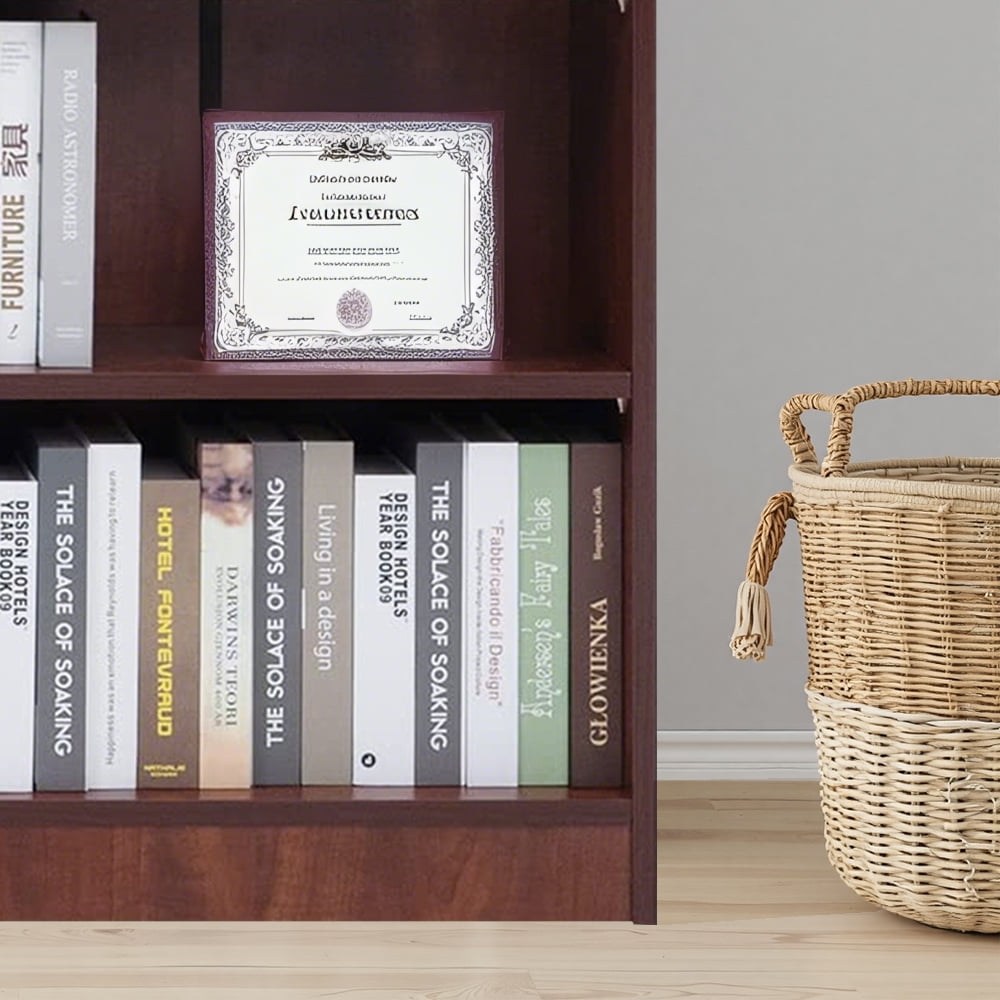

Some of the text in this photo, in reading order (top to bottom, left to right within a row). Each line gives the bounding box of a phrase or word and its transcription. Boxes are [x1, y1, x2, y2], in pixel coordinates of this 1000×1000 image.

[1, 124, 28, 177] 家具
[63, 70, 78, 240] RADIO ASTRONOMER
[1, 195, 24, 310] FURNITURE
[0, 501, 14, 542] YEAR
[13, 500, 28, 626] DESIGN HOTELS
[107, 552, 116, 571] was
[379, 493, 393, 534] YEAR
[394, 494, 408, 618] DESIGN HOTELS
[55, 485, 74, 756] THE SOLACE OF SOAKING
[157, 508, 172, 735] HOTEL FONTEVRAUD
[226, 567, 238, 725] DARWINS TEORI
[267, 478, 284, 747] THE SOLACE OF SOAKING
[313, 504, 337, 671] Living in a design
[430, 481, 449, 750] THE SOLACE OF SOAKING
[490, 629, 503, 639] il
[520, 497, 561, 718] Andersen's Fairy Tales
[589, 598, 607, 745] GŁOWIENKA
